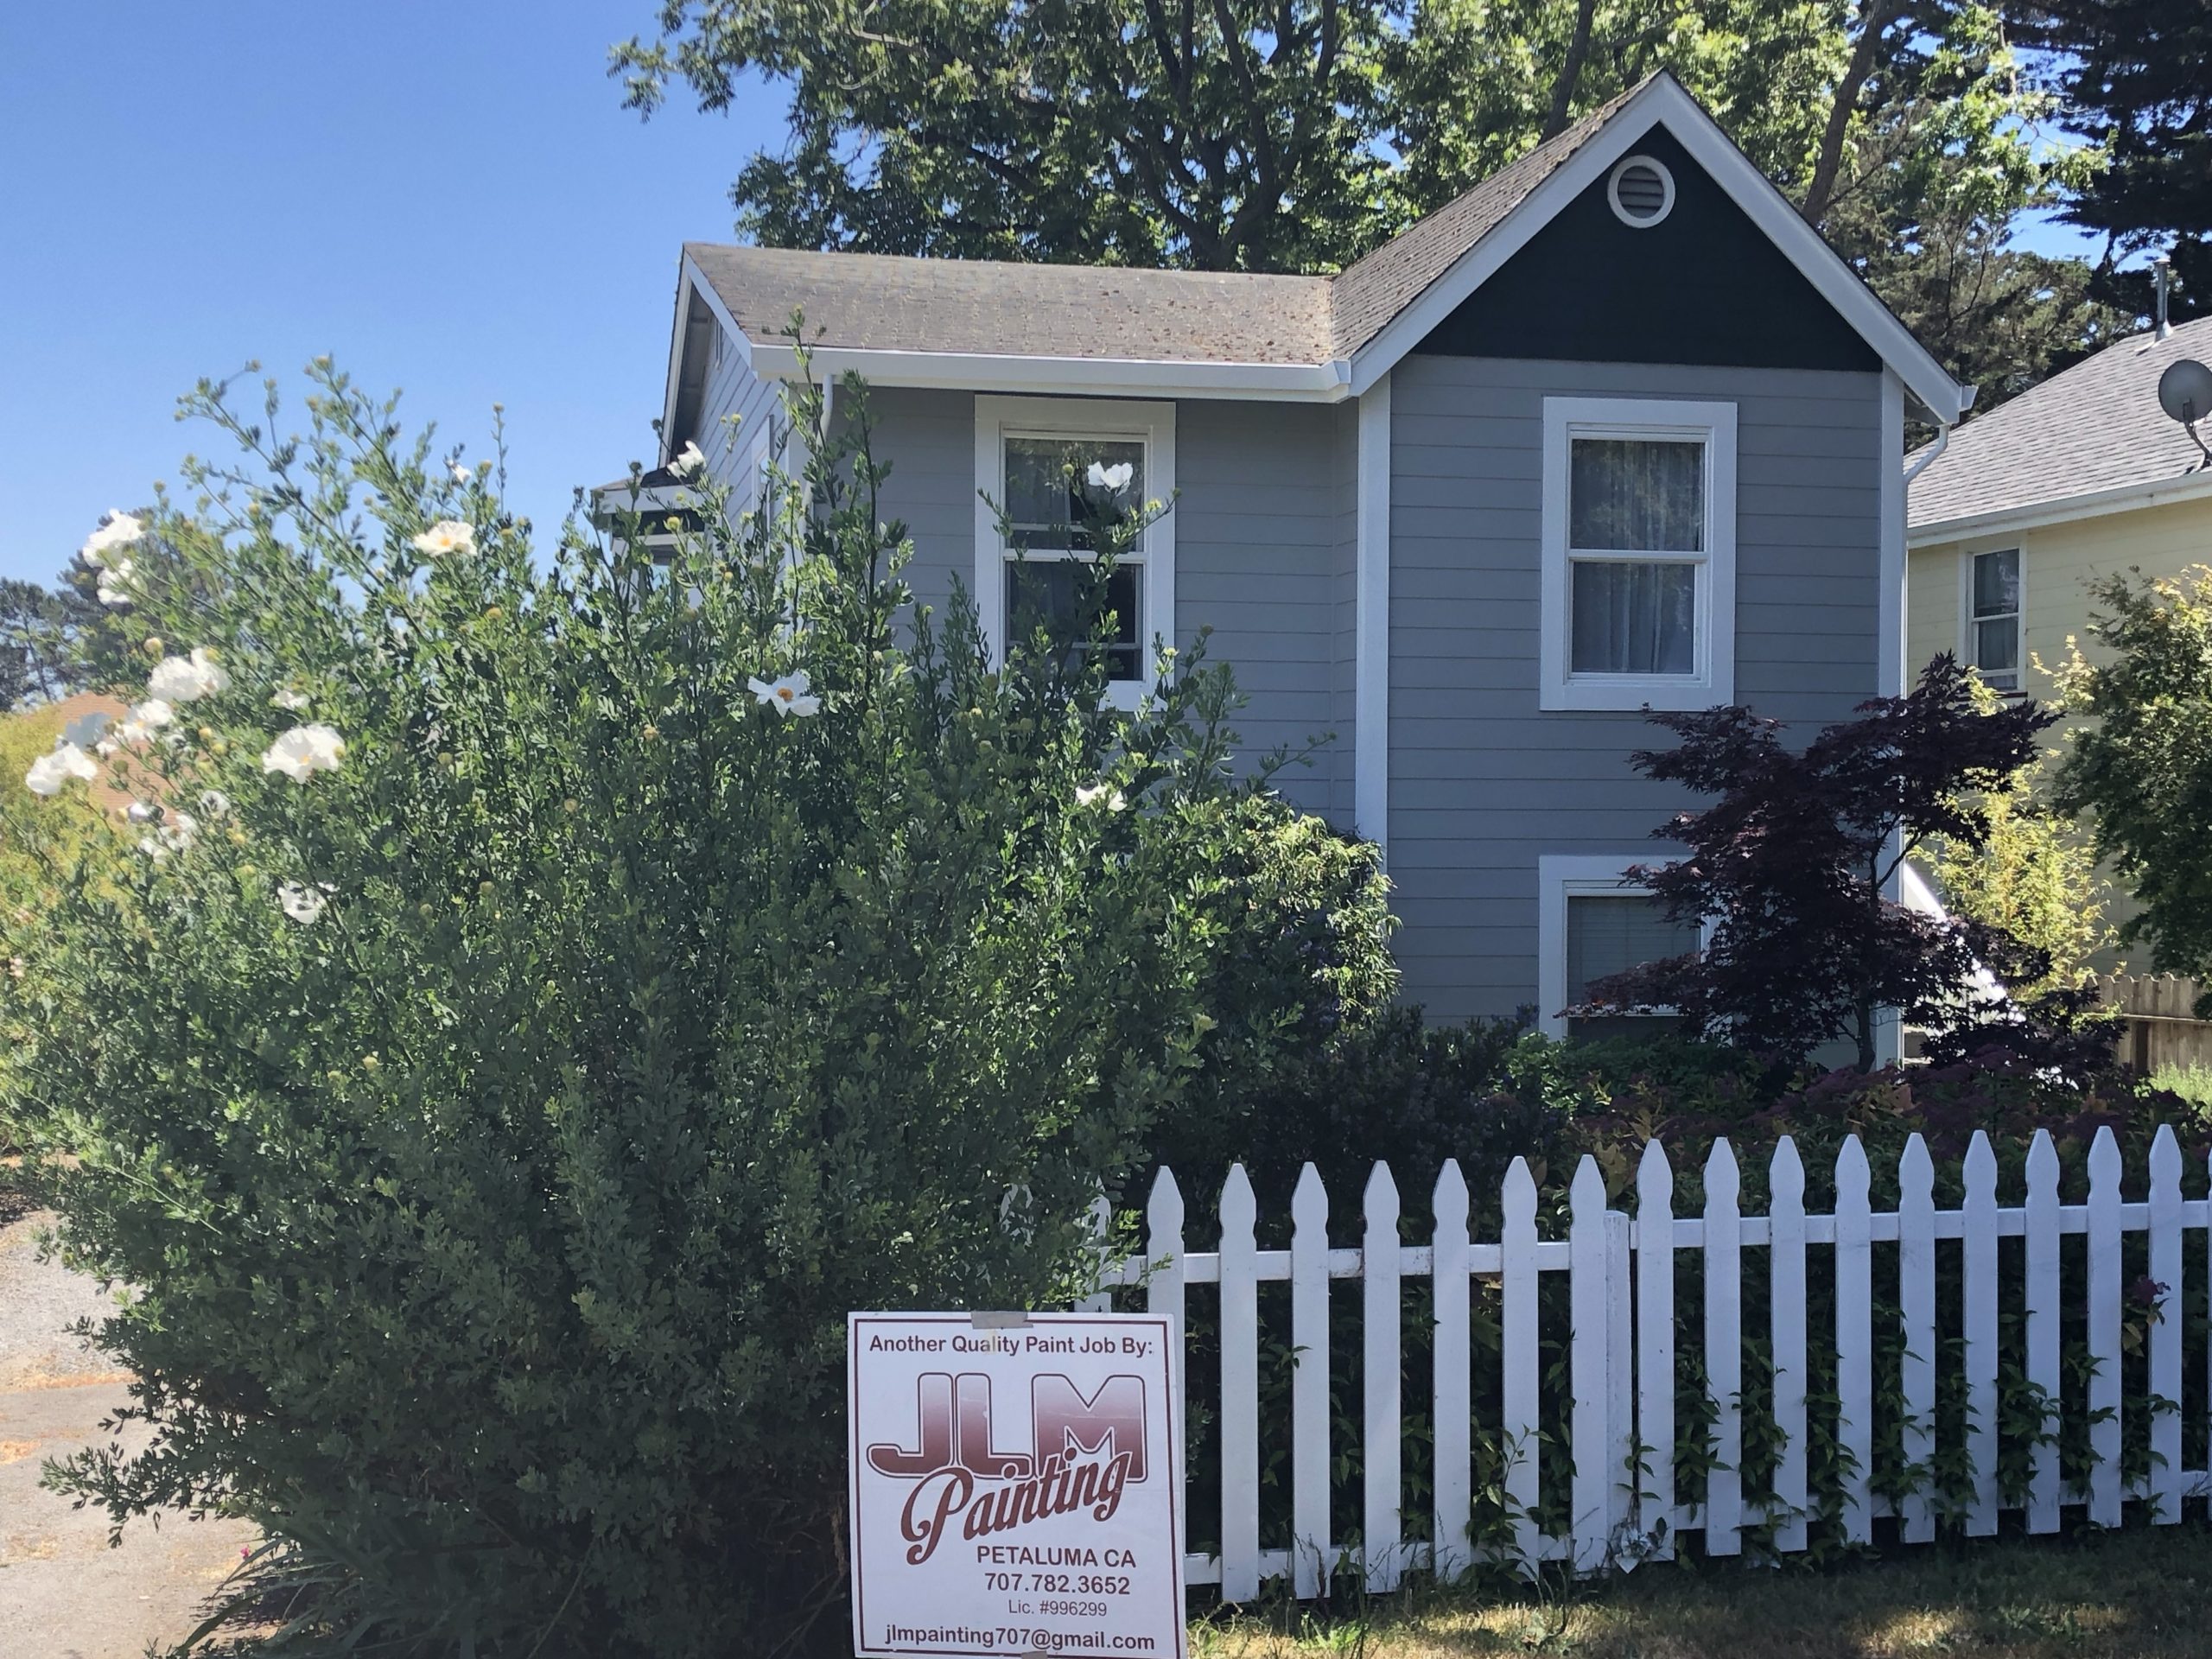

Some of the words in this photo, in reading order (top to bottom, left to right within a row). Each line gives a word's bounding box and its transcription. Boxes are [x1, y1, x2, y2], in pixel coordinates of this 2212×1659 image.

[869, 1335, 946, 1352] Another
[952, 1336, 1020, 1357] Quality
[1026, 1337, 1075, 1354] Paint
[1079, 1338, 1116, 1355] Job
[1122, 1338, 1154, 1358] By:
[867, 1372, 1148, 1484] JLM
[900, 1447, 1134, 1566] Painting
[977, 1546, 1097, 1567] PETALUMA
[1103, 1549, 1136, 1568] CA
[984, 1573, 1131, 1595] 707.782.3652
[1007, 1599, 1035, 1615] Lic.
[1039, 1600, 1108, 1617] #996299
[885, 1624, 1154, 1650] jlmpainting707@gmail.com
